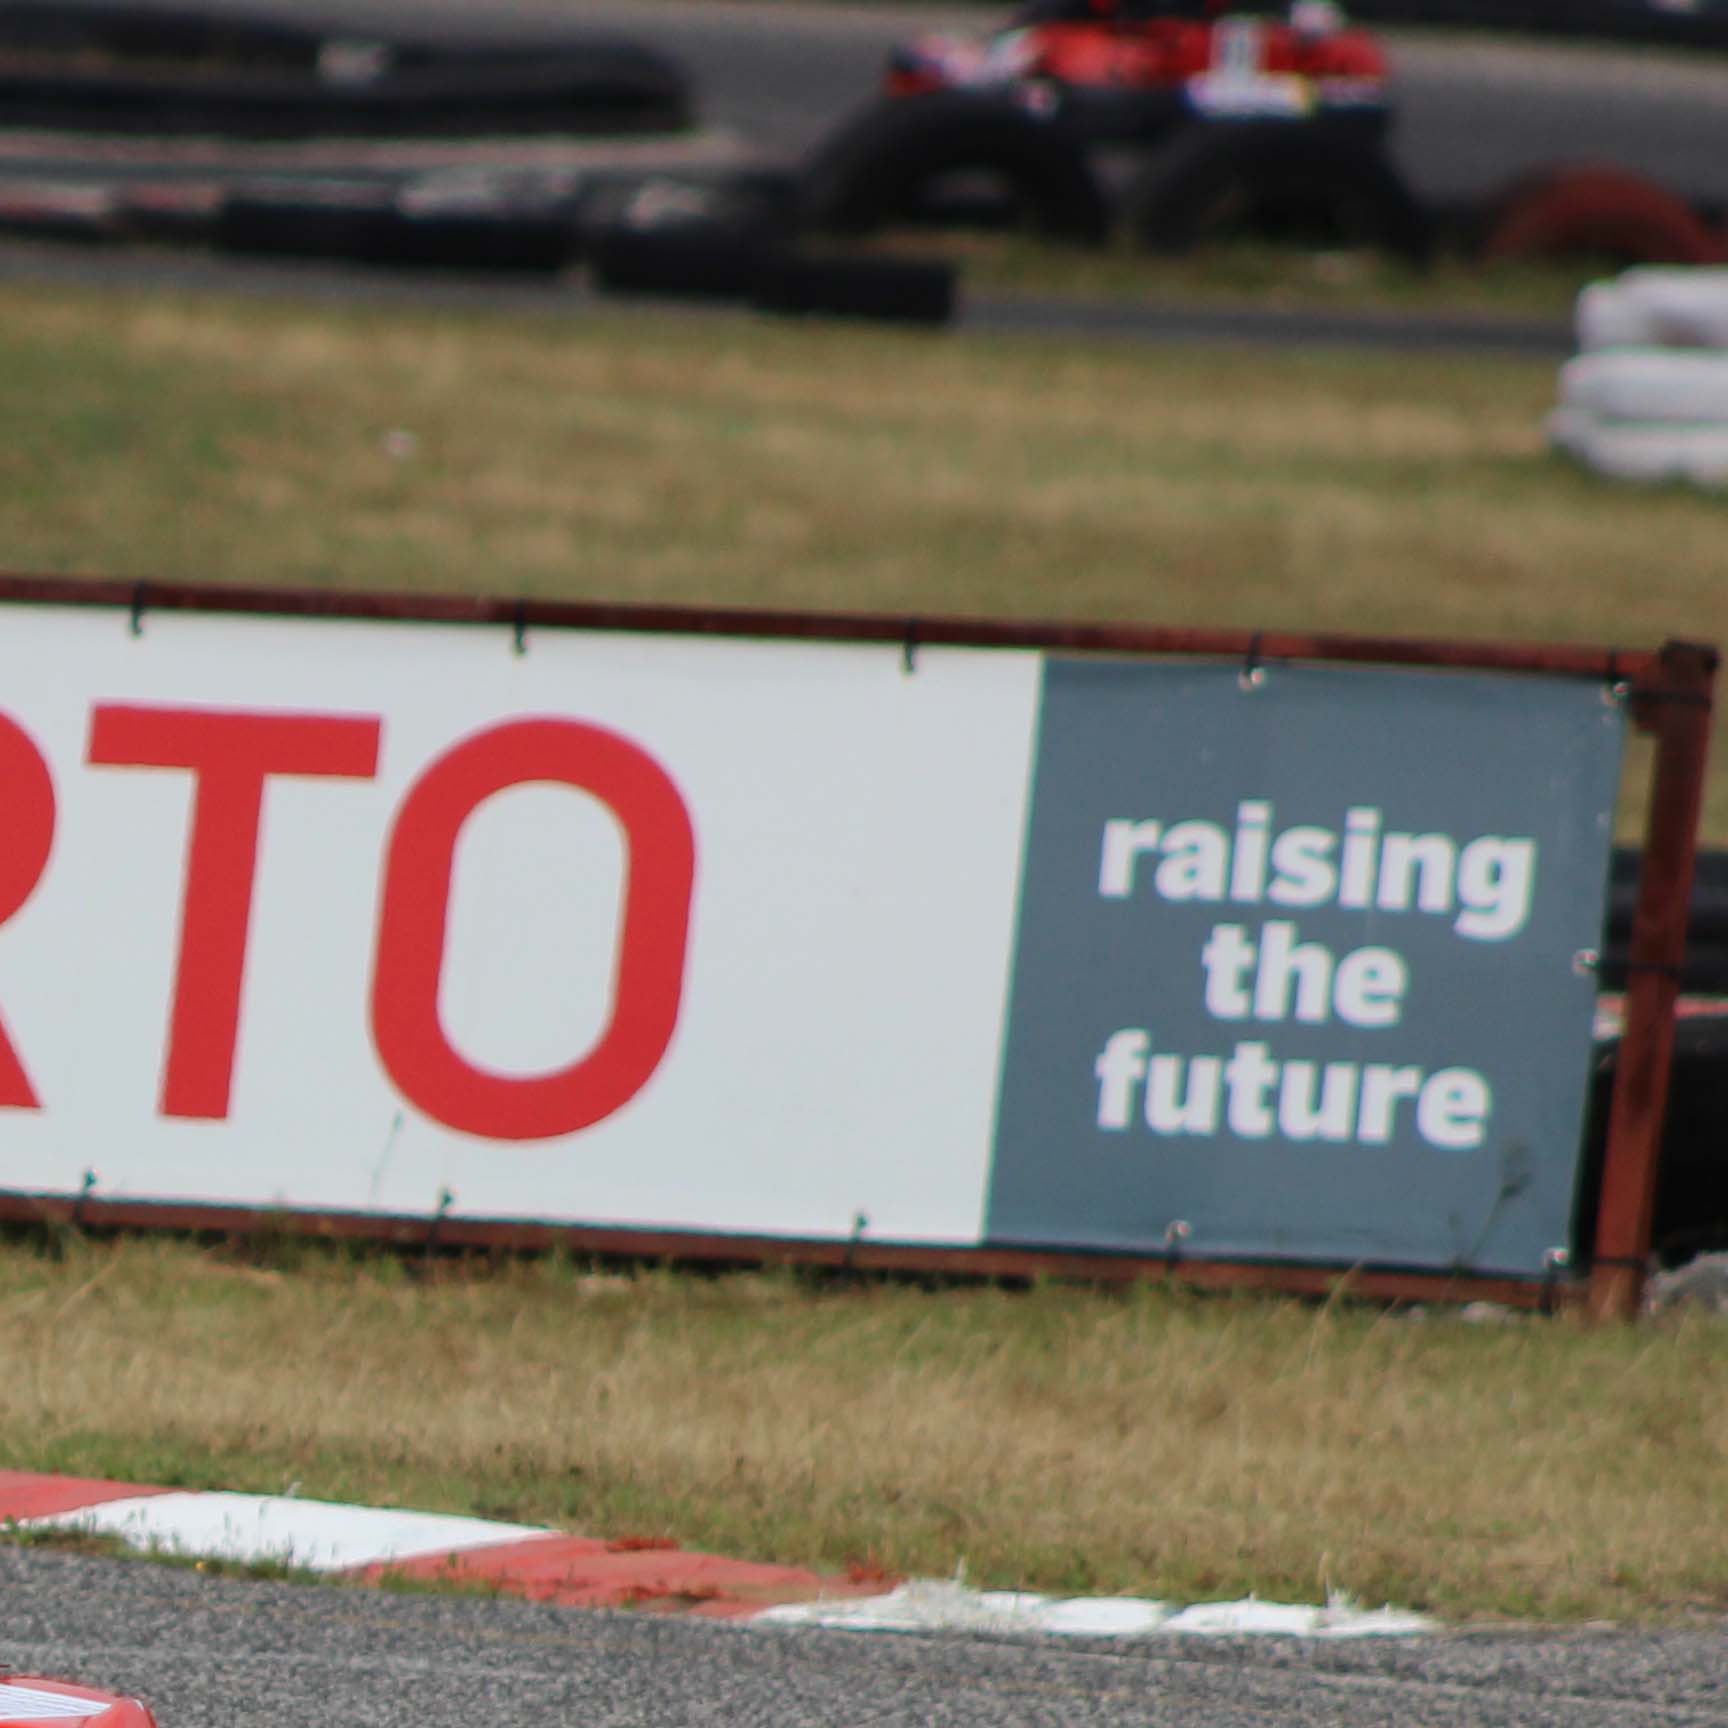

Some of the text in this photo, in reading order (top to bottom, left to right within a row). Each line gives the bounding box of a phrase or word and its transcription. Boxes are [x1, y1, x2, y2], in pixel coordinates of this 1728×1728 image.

[1098, 800, 1536, 941] raising
[1202, 920, 1407, 1027] the
[1094, 1028, 1492, 1148] future
